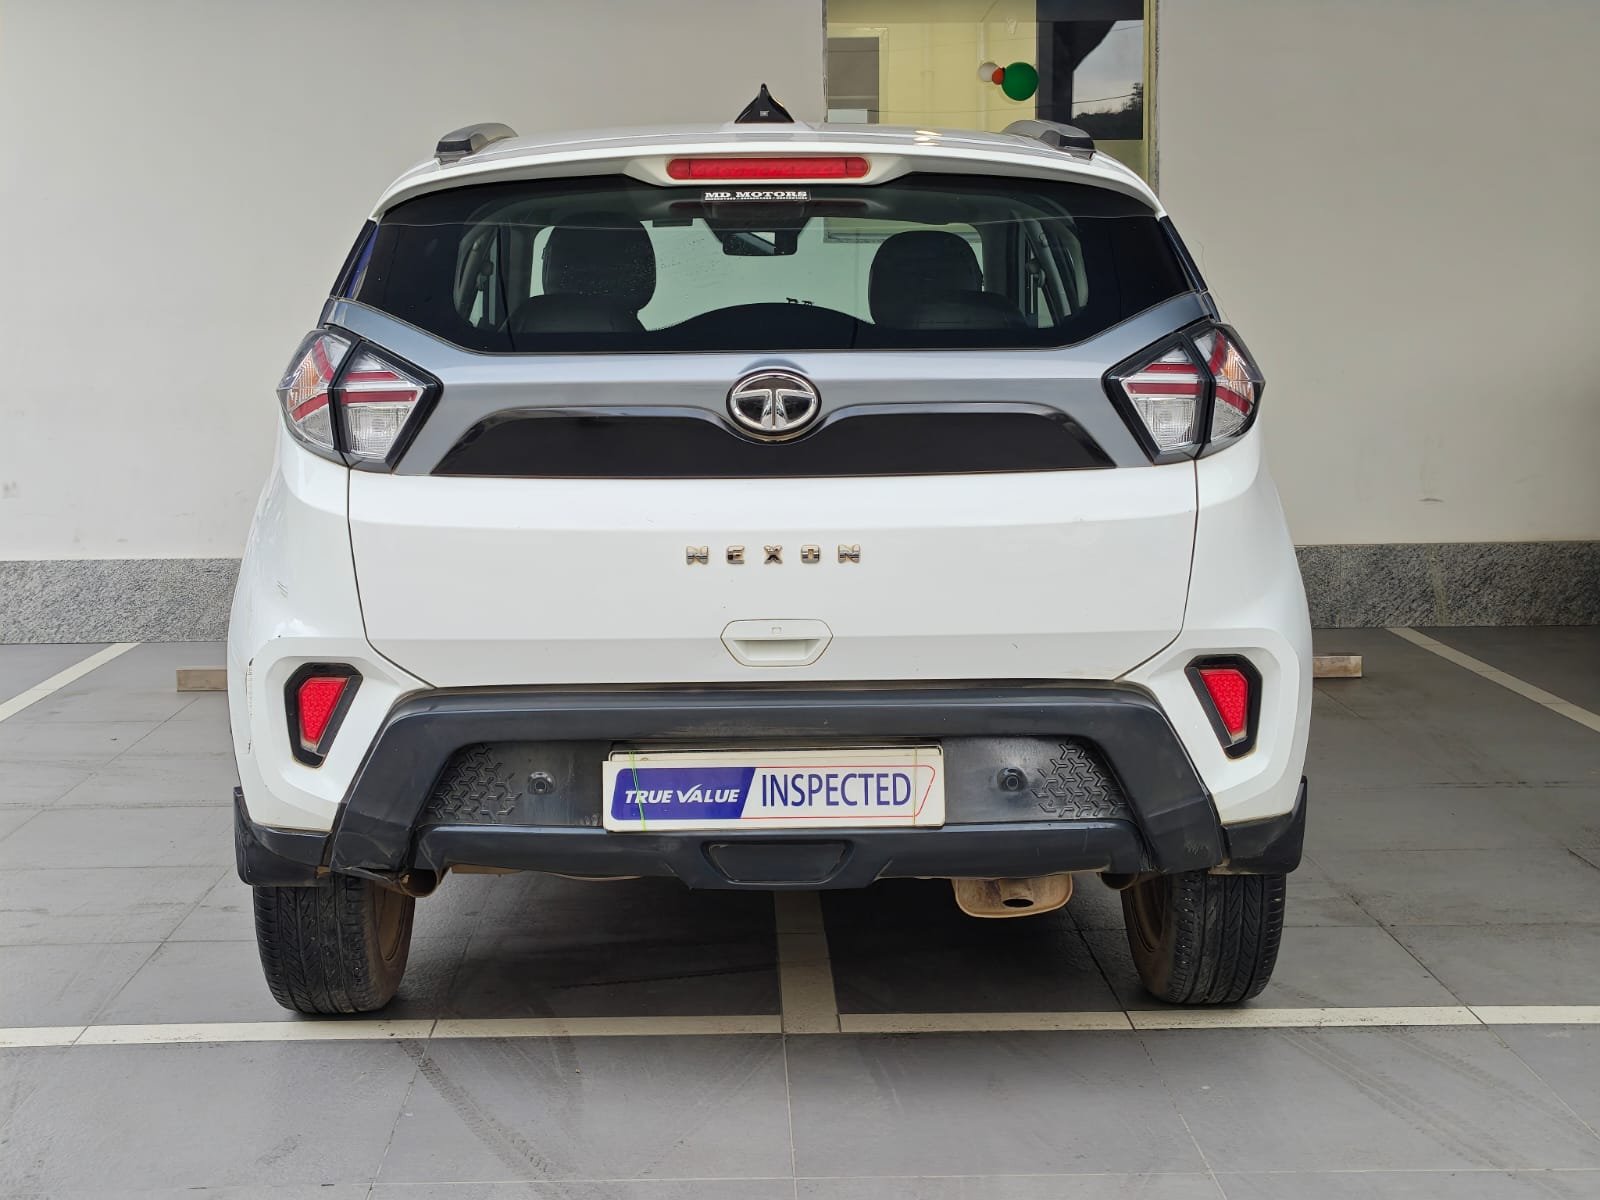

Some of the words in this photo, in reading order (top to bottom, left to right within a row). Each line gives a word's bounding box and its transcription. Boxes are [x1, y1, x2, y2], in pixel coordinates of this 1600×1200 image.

[686, 545, 861, 565] NEXON
[624, 789, 673, 805] TRUE
[676, 784, 741, 804] VALUE
[761, 772, 911, 807] INSPECTED
